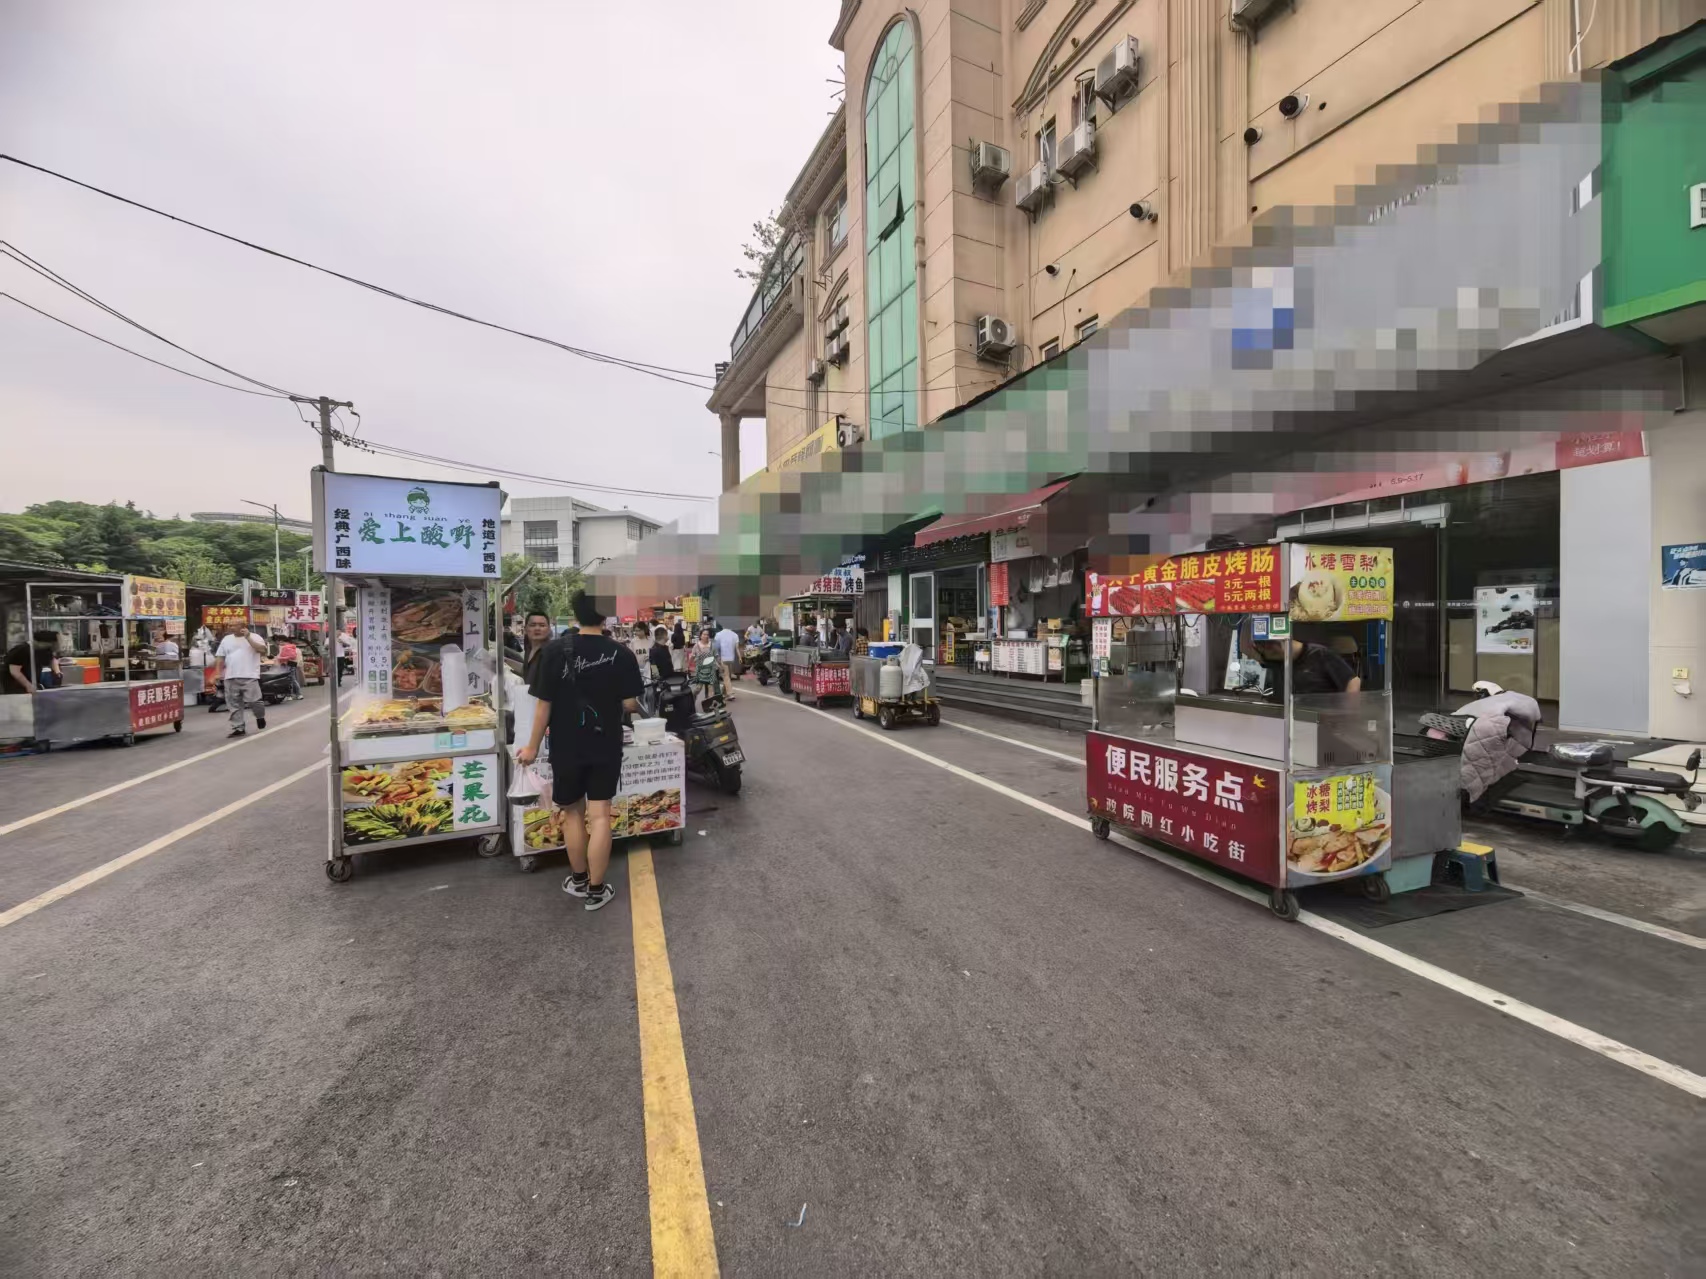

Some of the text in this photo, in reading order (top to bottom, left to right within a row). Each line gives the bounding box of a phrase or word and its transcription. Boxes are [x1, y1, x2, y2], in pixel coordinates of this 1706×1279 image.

[384, 512, 416, 521] shang
[334, 508, 352, 569] 经典广西味
[358, 517, 476, 549] 爱上酸嘢
[482, 518, 496, 574] 地道广西酸
[1108, 547, 1274, 587] 黄金脆皮烤肠
[1224, 576, 1271, 590] 3元一根
[1224, 589, 1271, 602] 5元两根
[287, 606, 321, 620] 炸串
[1105, 744, 1245, 813] 便民服务点
[457, 760, 491, 824] 芒果花
[1306, 783, 1331, 799] 冰糖
[1306, 799, 1331, 814] 烤梨
